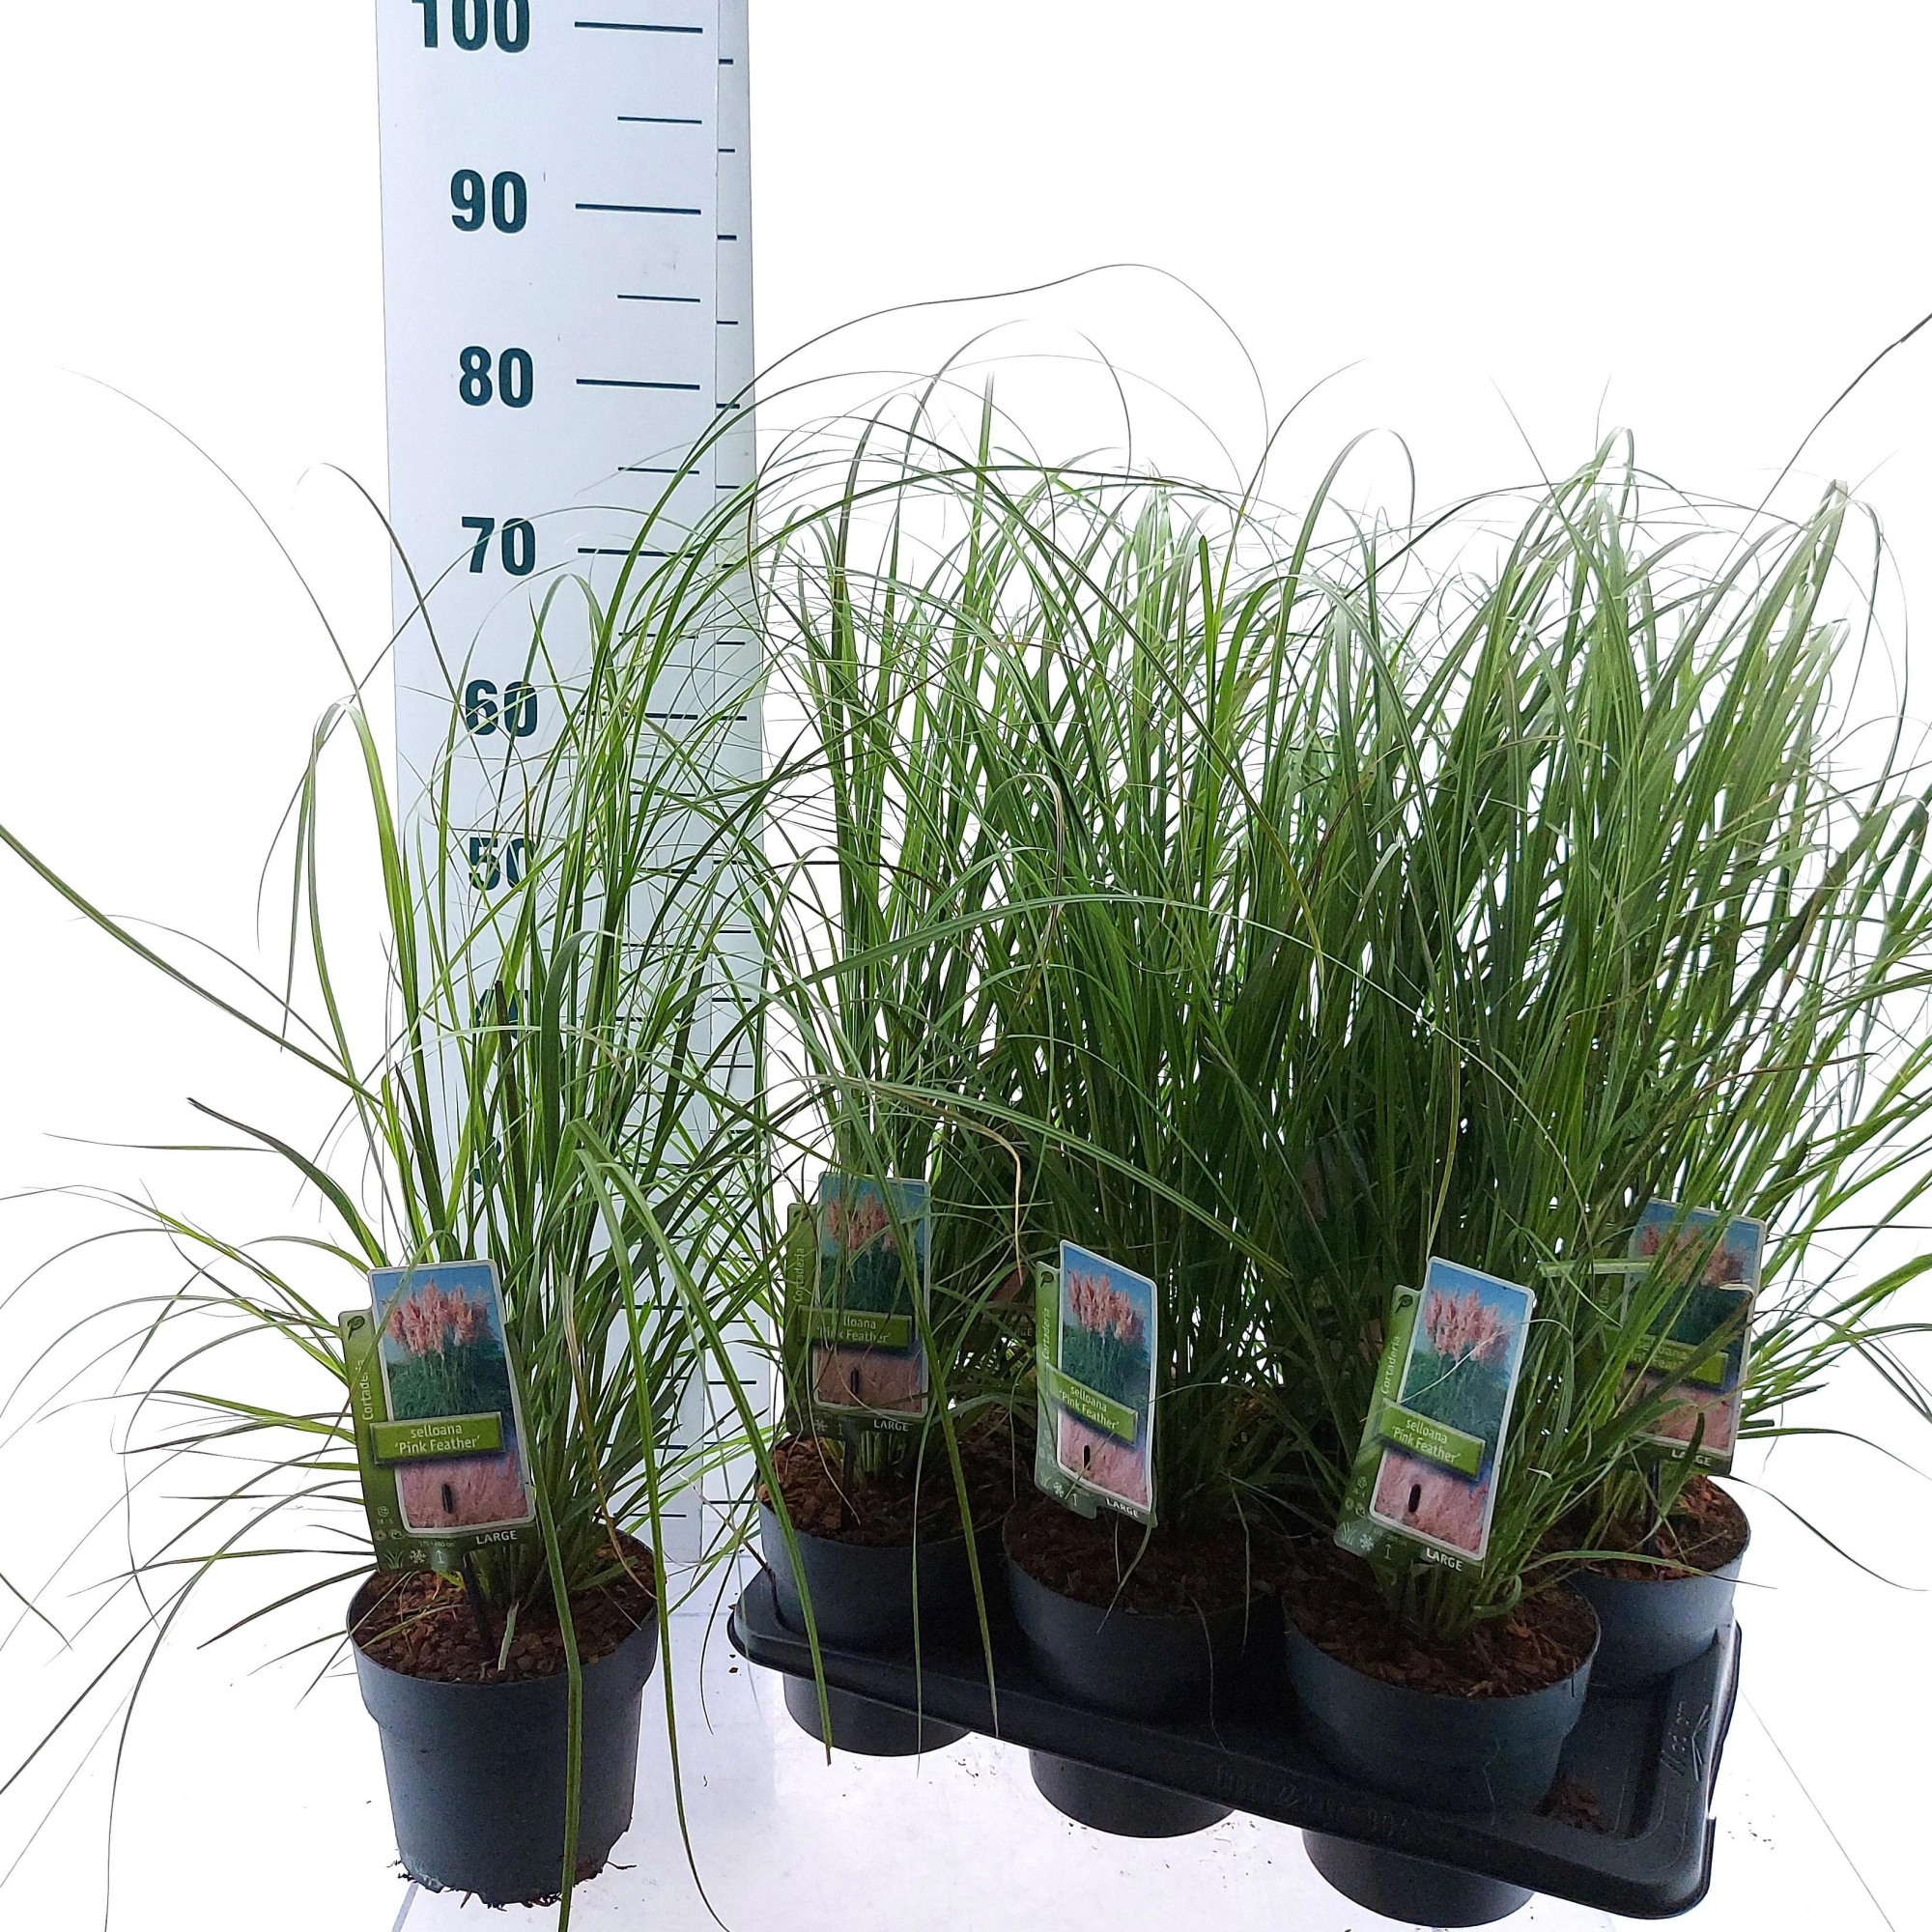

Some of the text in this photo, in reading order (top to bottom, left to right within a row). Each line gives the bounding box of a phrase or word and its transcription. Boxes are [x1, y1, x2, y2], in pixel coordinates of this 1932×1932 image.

[412, 0, 530, 52] 100
[450, 168, 527, 234] 90
[459, 345, 534, 409] 80
[461, 516, 536, 577] 70
[465, 678, 538, 738] 60
[1042, 1307, 1051, 1360] Cortaderia
[1380, 1335, 1401, 1394] Cortaderia
[1070, 1385, 1107, 1412] selloana
[411, 1423, 463, 1438] selloana
[873, 1418, 909, 1433] LARGE
[1406, 1418, 1448, 1444] selloana
[1671, 1448, 1713, 1466] LAGE
[1106, 1497, 1139, 1519] LARGE
[475, 1529, 518, 1546] LARGE
[1426, 1547, 1463, 1572] LARGE
